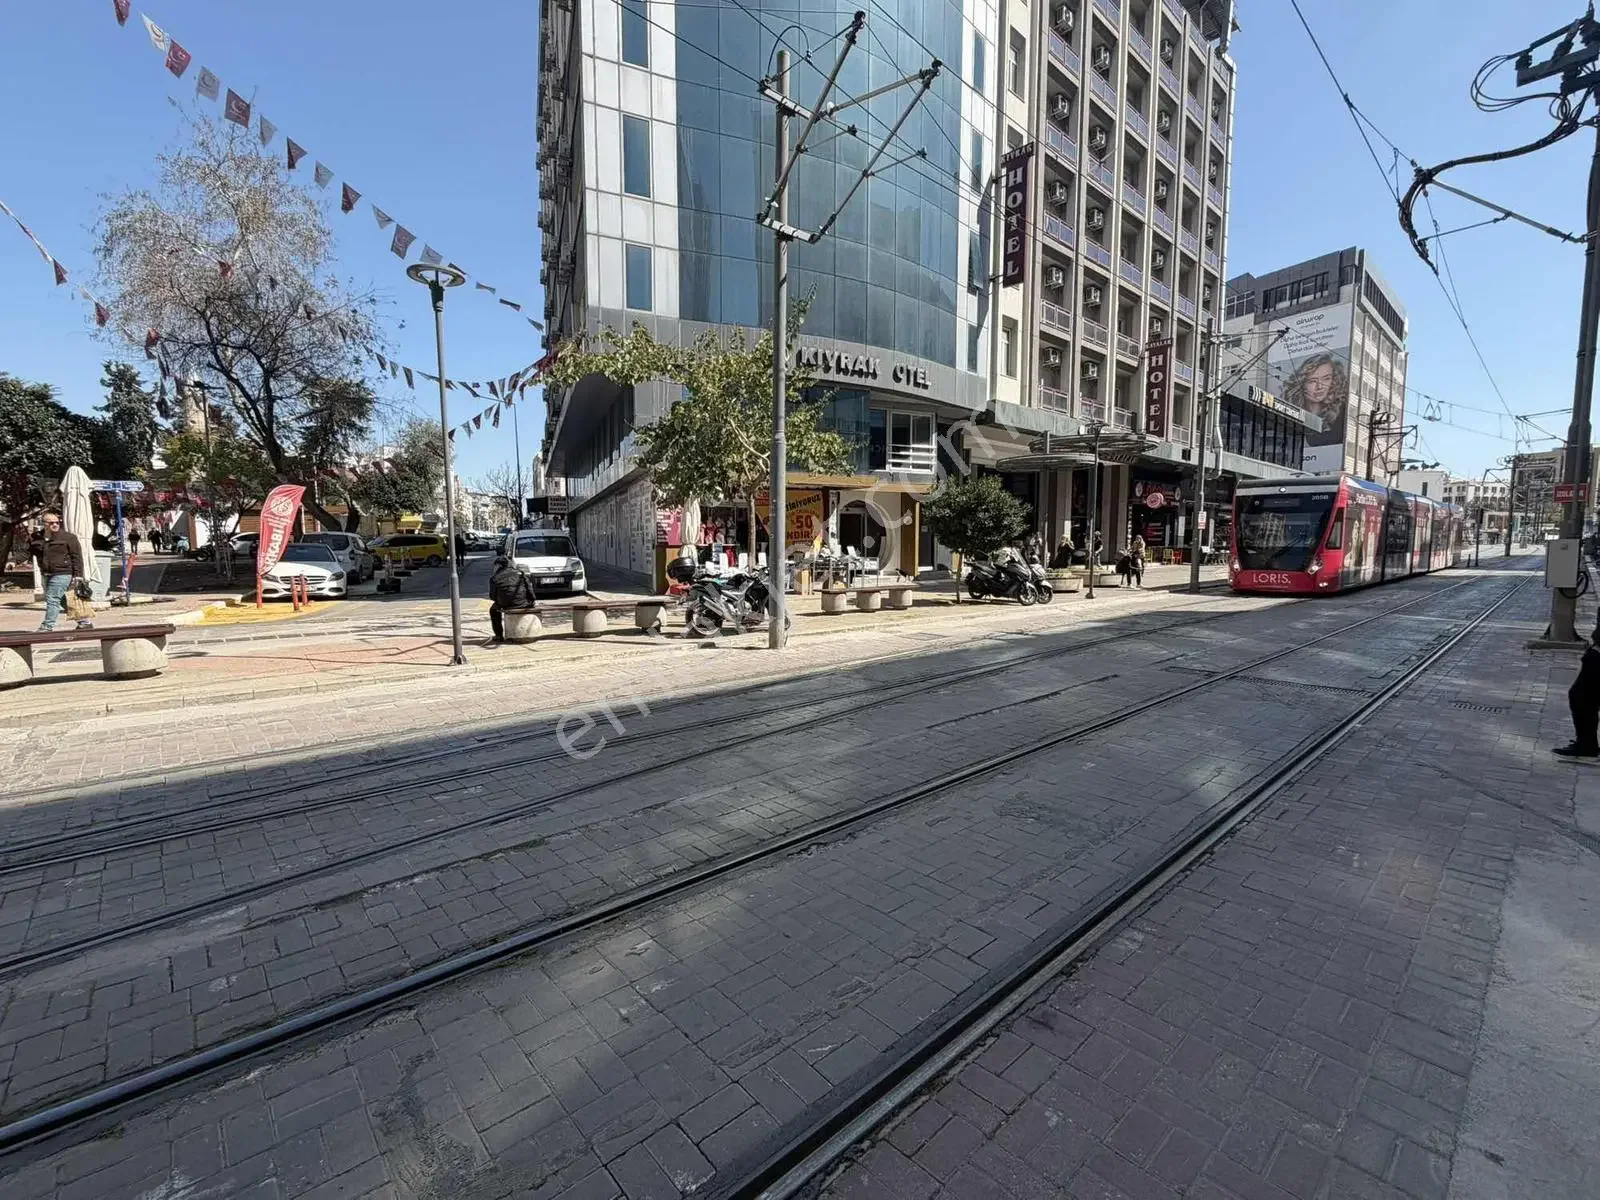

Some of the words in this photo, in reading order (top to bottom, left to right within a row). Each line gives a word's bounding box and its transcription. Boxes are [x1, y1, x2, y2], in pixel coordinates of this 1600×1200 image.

[1007, 167, 1024, 276] HOTEL
[892, 362, 932, 389] OTEL
[1149, 354, 1164, 432] HOTEL
